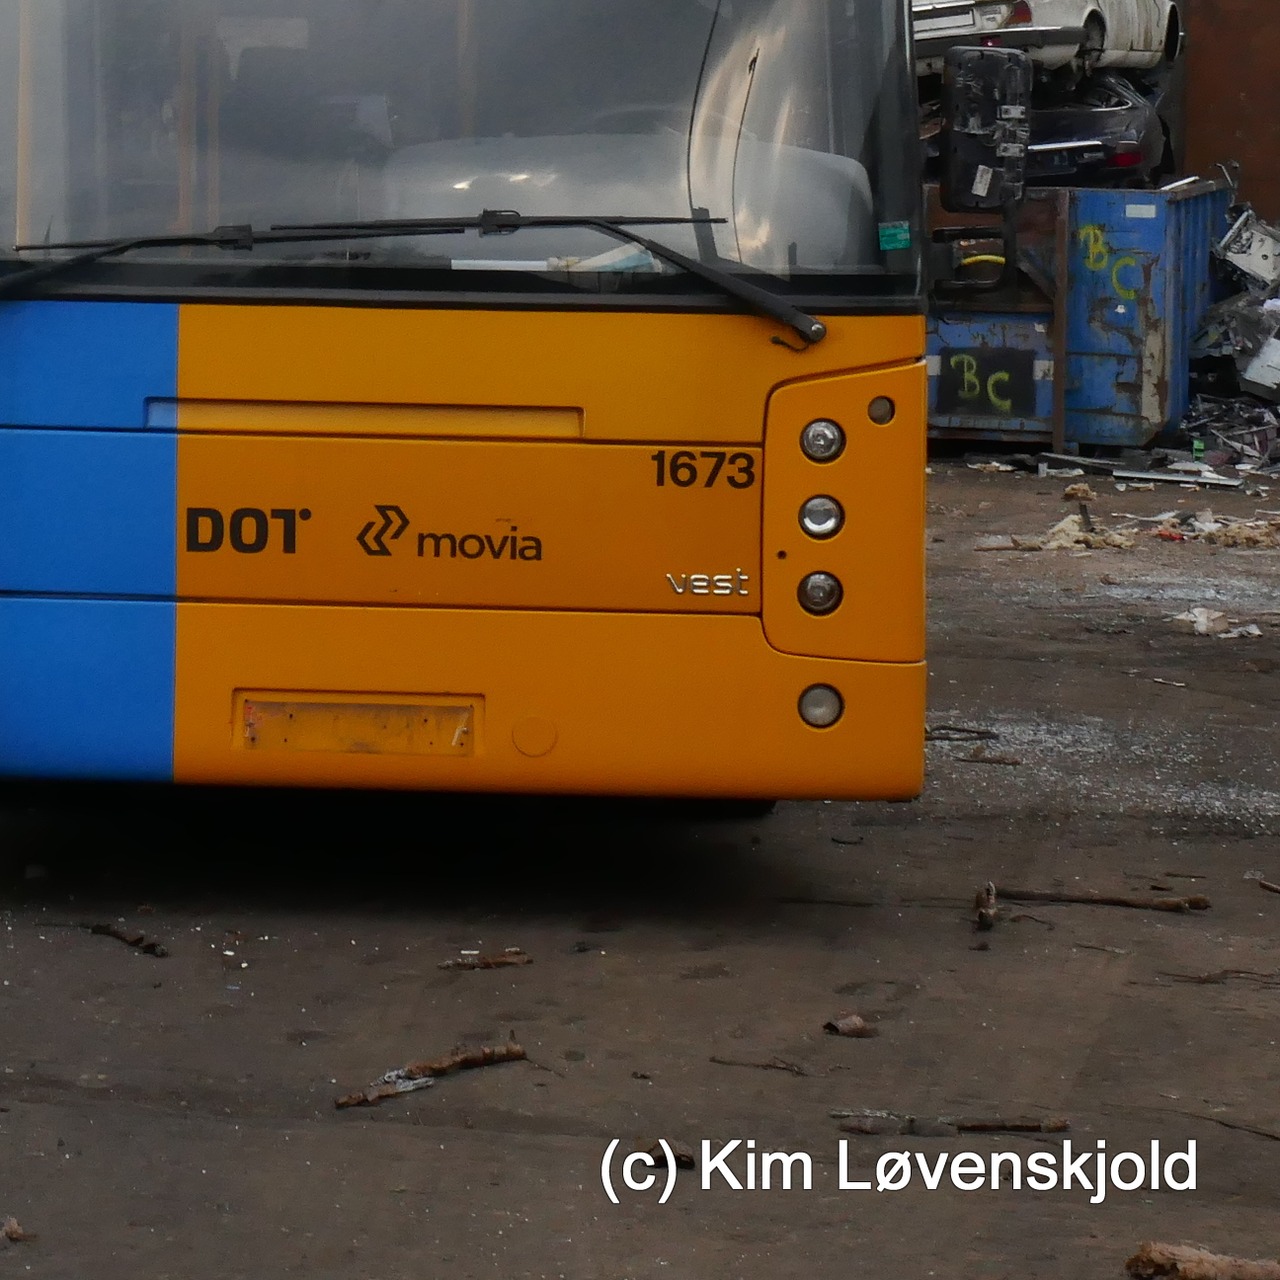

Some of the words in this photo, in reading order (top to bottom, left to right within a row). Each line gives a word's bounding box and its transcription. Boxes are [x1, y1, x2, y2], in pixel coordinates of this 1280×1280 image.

[651, 450, 756, 490] 1673
[186, 506, 312, 554] DOT
[416, 525, 543, 562] movia
[665, 567, 749, 595] vest
